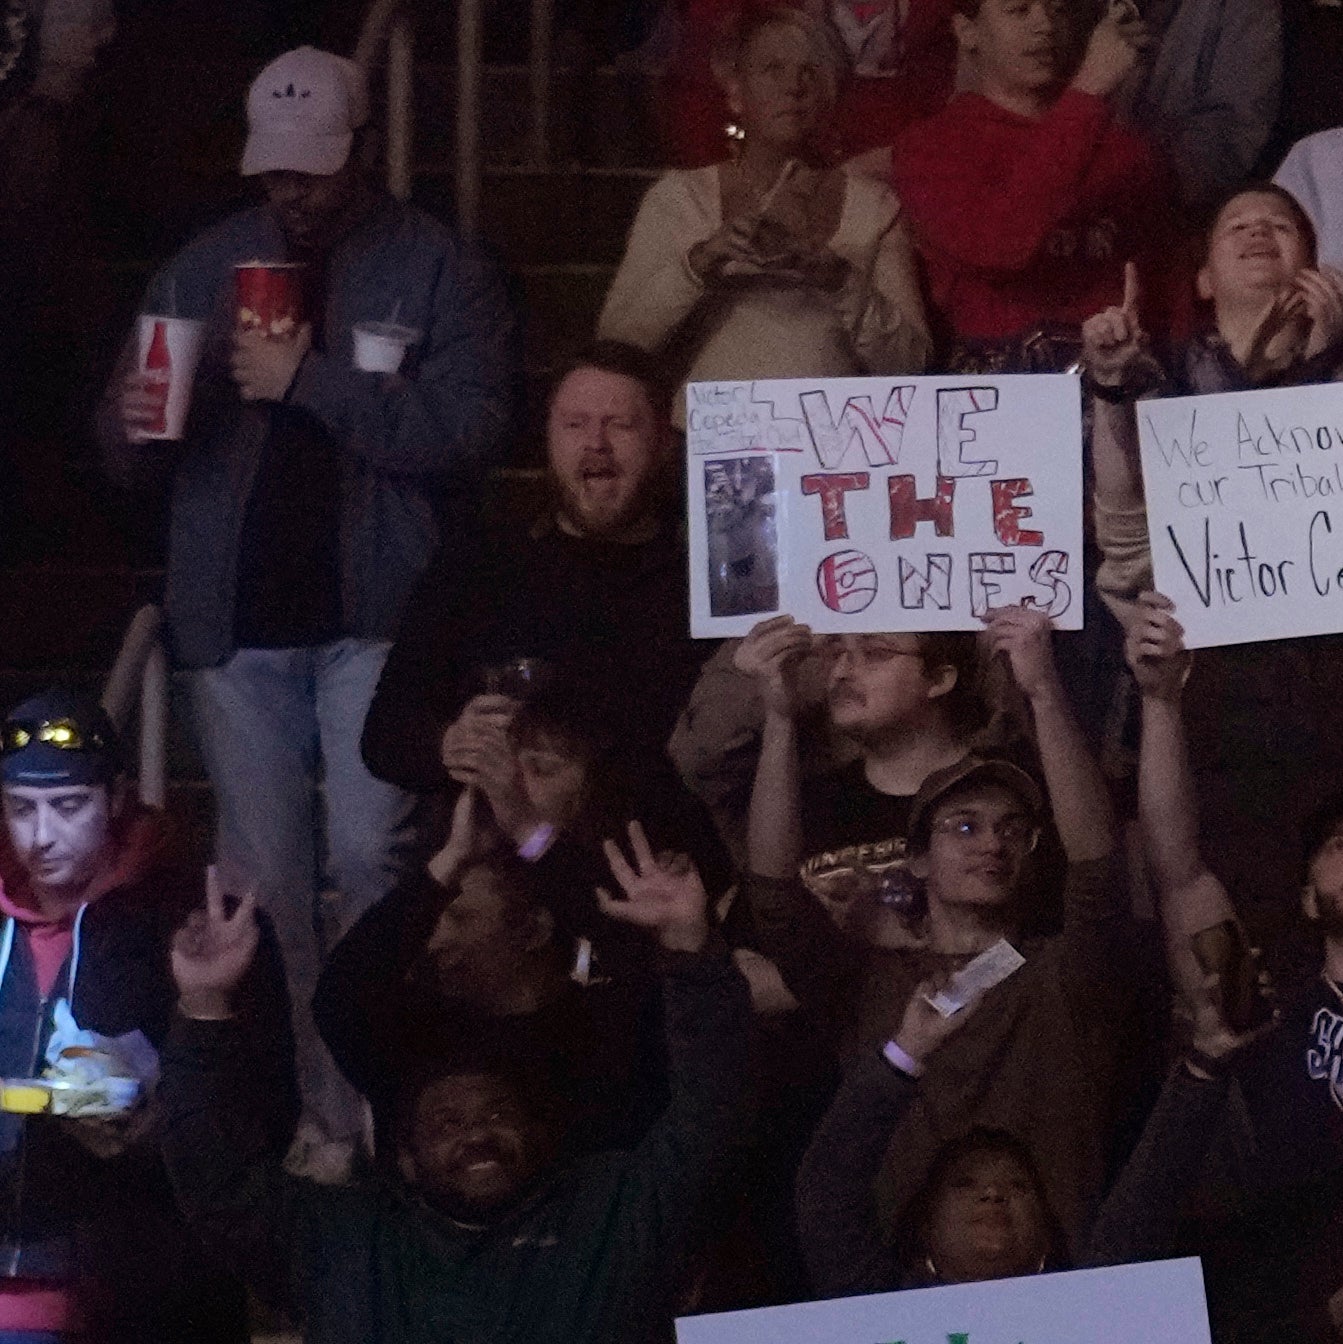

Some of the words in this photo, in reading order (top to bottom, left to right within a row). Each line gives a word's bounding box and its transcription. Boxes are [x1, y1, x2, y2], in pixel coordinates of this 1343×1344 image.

[799, 385, 999, 479] WE
[1146, 409, 1212, 469] We
[801, 472, 1044, 547] THE
[1237, 462, 1343, 503] Tribal
[816, 549, 1072, 618] ONES
[1166, 516, 1295, 608] Victor
